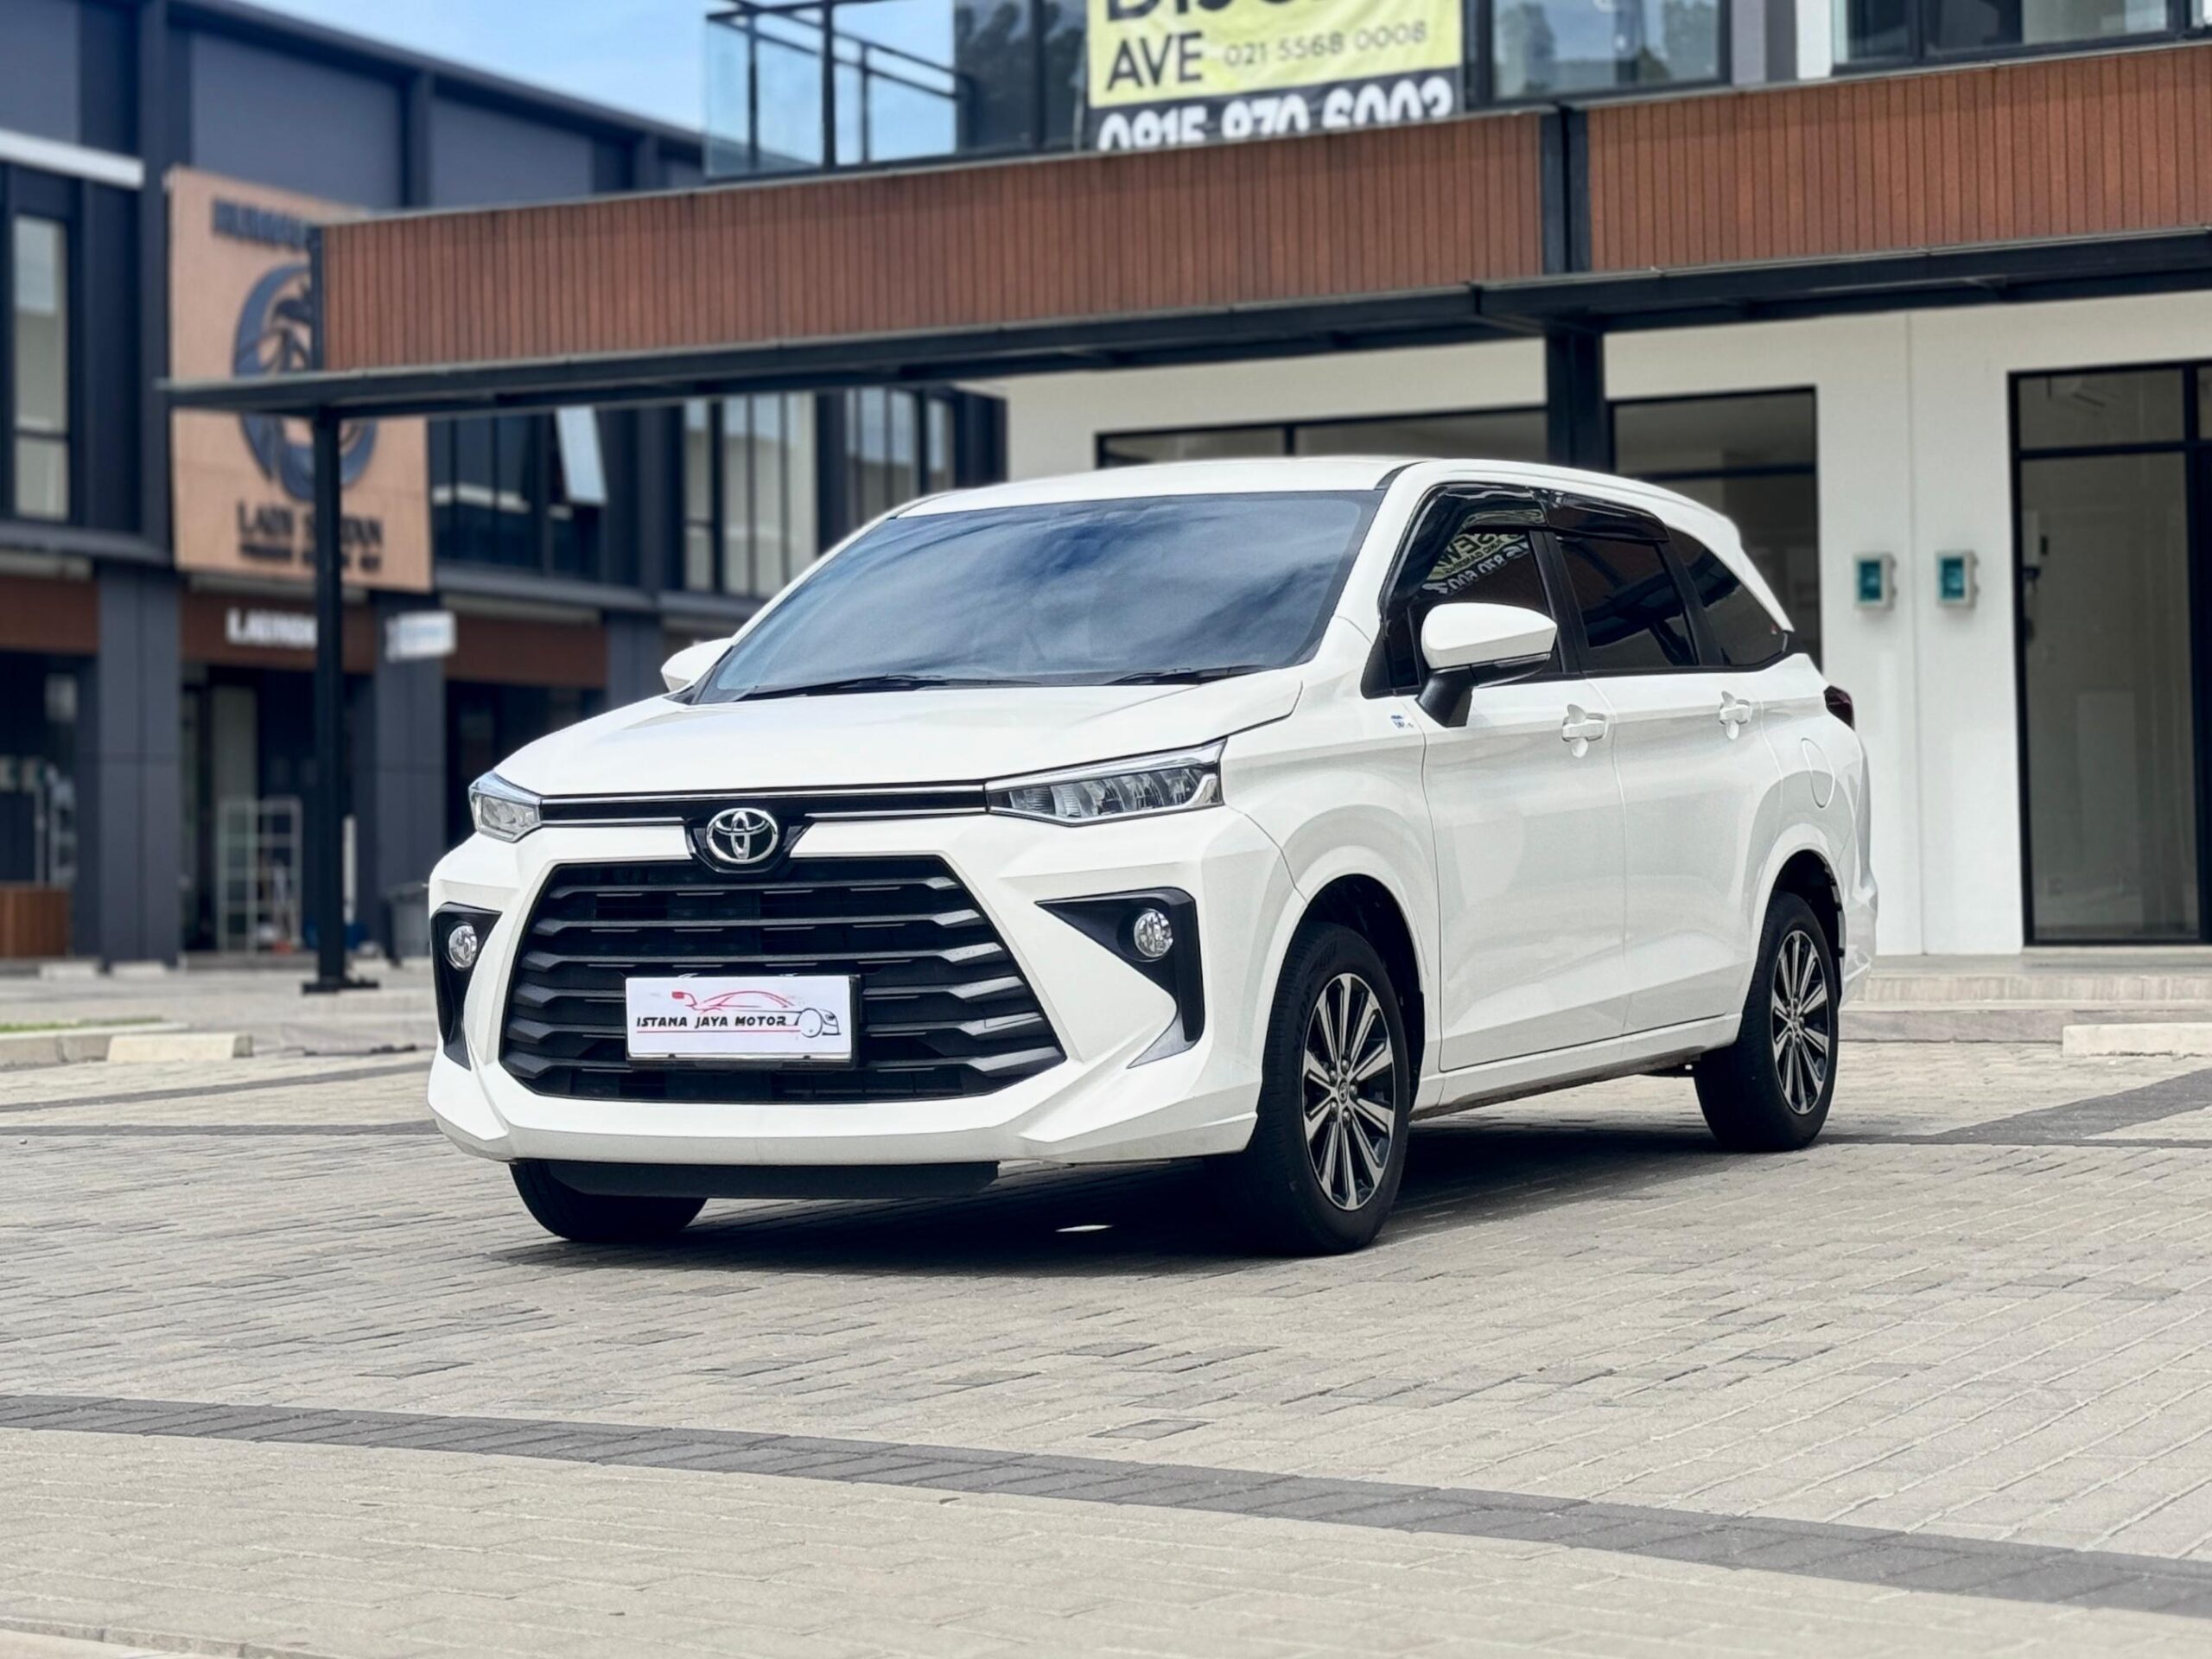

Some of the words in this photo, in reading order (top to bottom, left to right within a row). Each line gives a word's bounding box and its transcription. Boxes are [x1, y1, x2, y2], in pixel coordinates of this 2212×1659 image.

[1106, 31, 1203, 92] AVE
[1224, 42, 1268, 67] 021
[1277, 31, 1344, 60] 5568
[1354, 20, 1427, 51] 0008
[636, 1016, 688, 1027] ISTANA
[695, 1016, 728, 1028] JAYA
[734, 1015, 786, 1027] MOTOR
